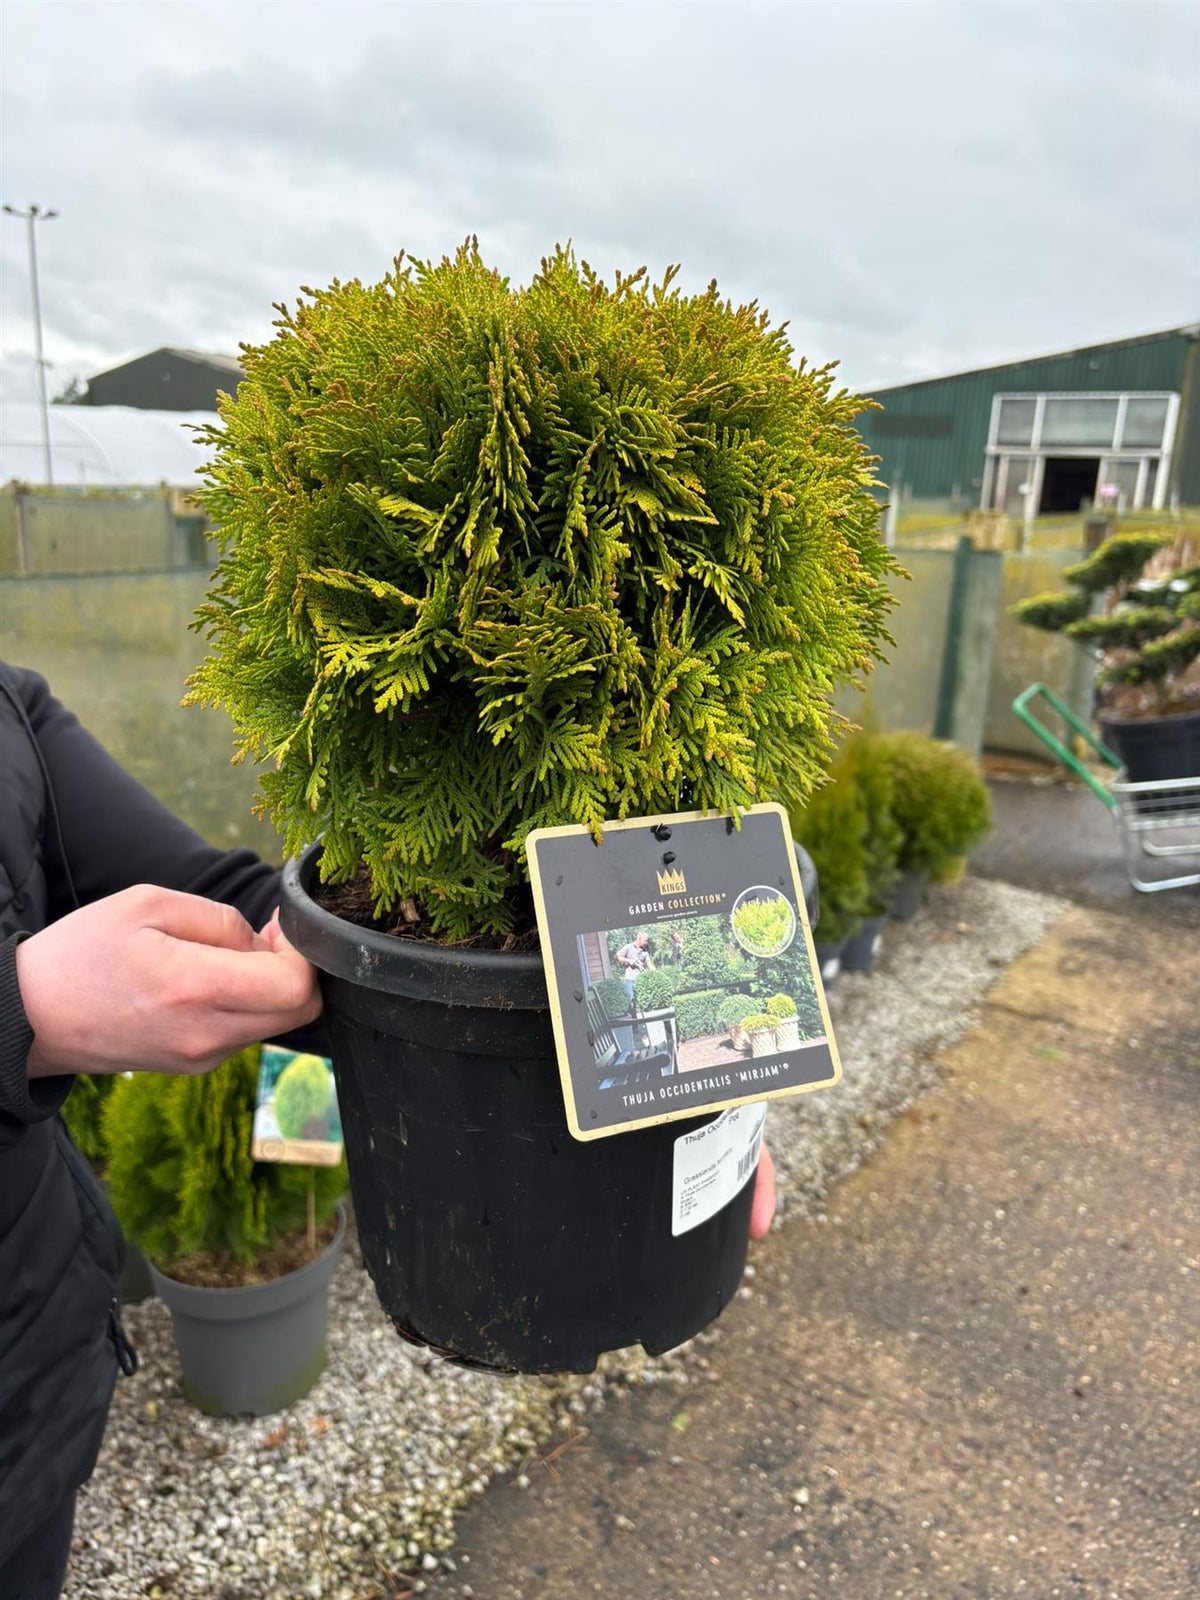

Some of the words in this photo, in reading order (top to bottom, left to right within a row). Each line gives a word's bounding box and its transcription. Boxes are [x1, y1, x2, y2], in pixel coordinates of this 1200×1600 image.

[661, 882, 685, 893] KINGS
[628, 901, 664, 915] GARDEN
[622, 1090, 655, 1107] THUJA
[660, 1074, 732, 1099] OCCIDENTALIS
[684, 1131, 706, 1145] Thuja
